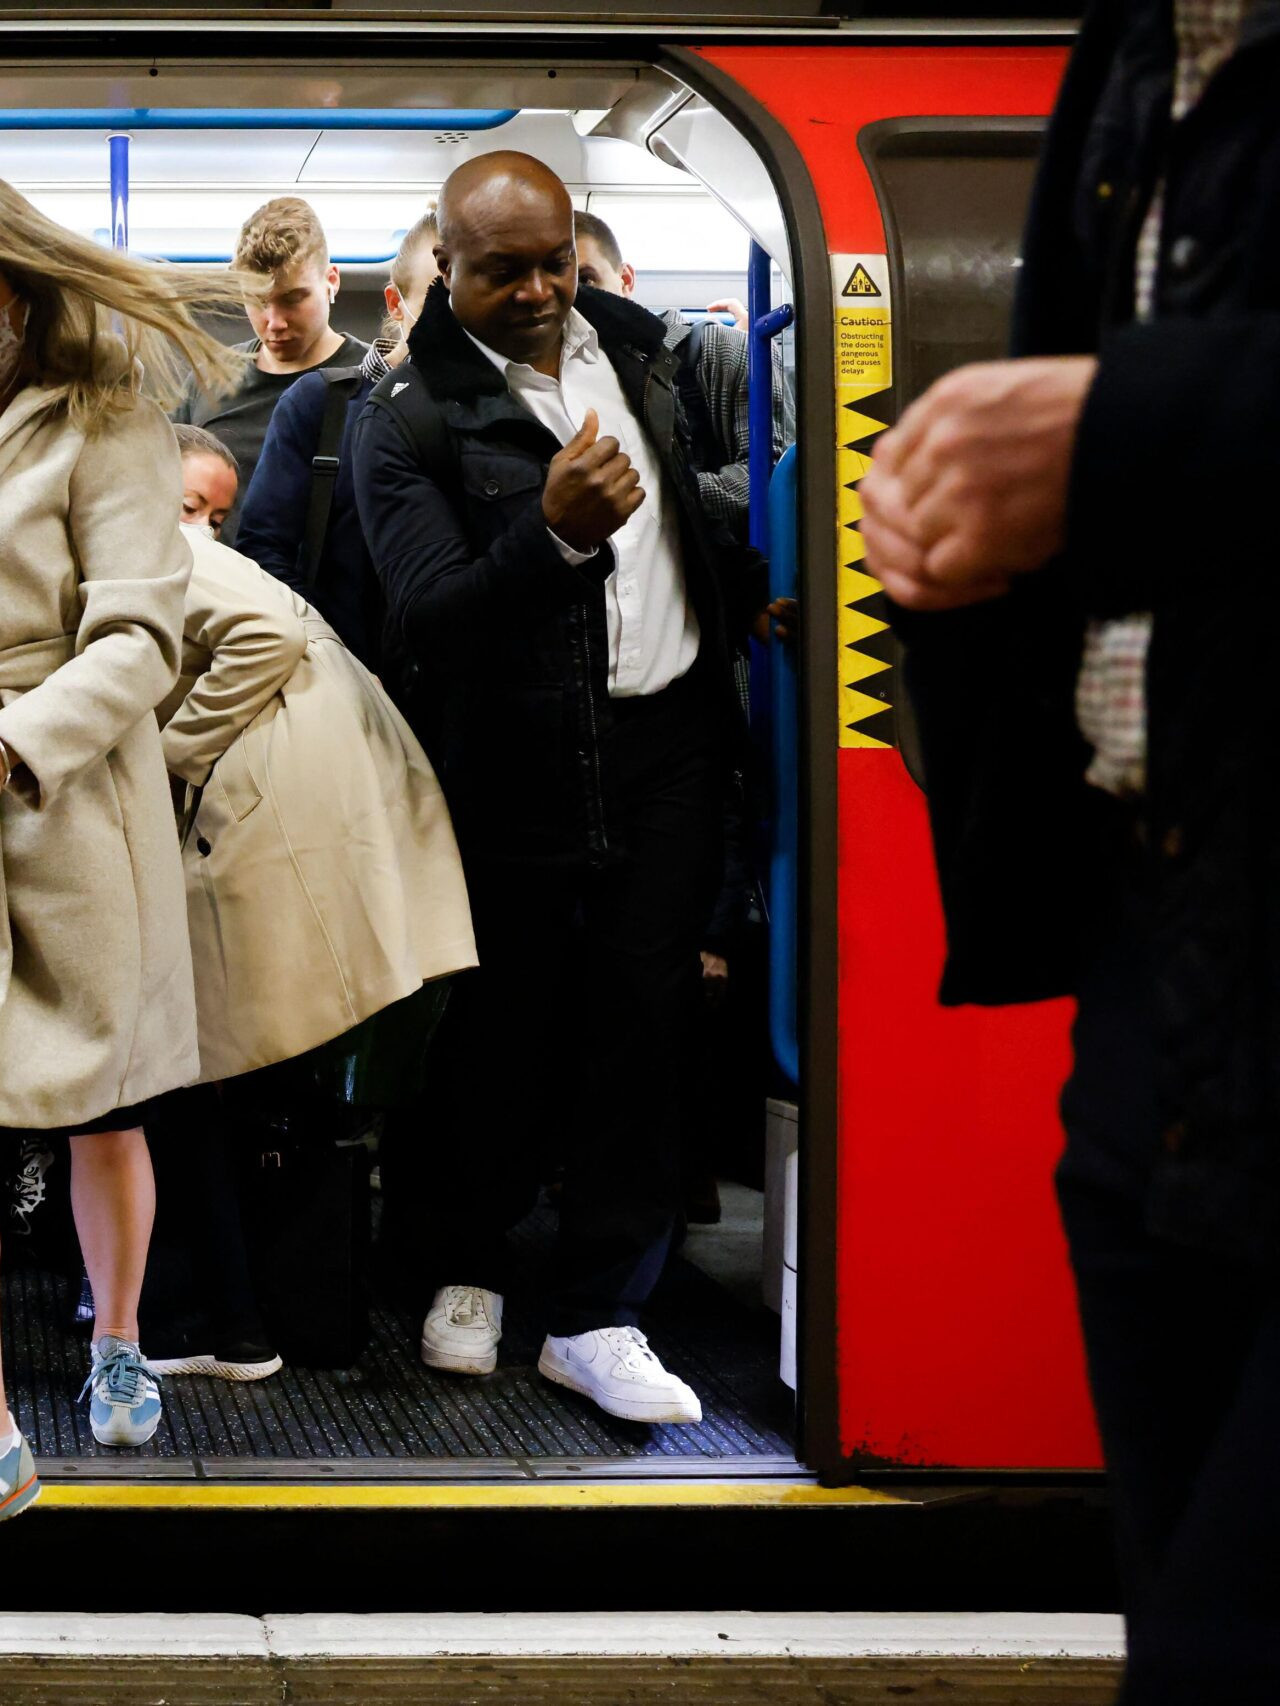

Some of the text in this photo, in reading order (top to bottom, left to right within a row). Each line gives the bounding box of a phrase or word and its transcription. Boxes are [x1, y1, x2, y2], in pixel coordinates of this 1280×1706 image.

[840, 316, 884, 326] Caution
[840, 333, 884, 341] Obstructing
[841, 350, 879, 358] dangerous
[841, 367, 865, 375] delays
